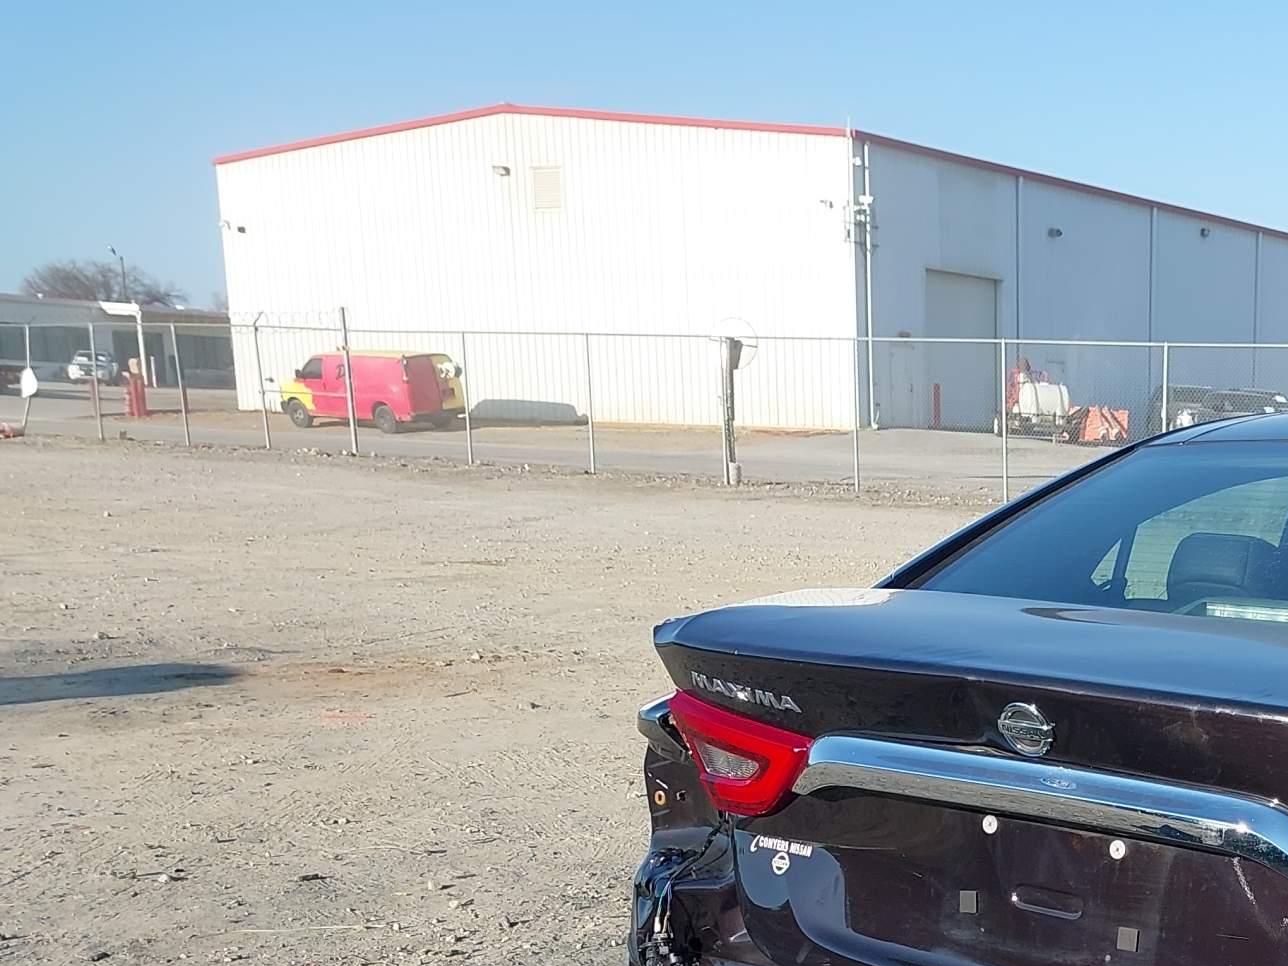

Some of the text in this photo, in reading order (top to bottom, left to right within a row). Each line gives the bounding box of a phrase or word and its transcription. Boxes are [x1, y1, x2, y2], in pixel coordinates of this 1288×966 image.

[690, 671, 802, 713] MAXIMA
[1001, 724, 1046, 738] NISSAN
[789, 842, 813, 857] NISSAN
